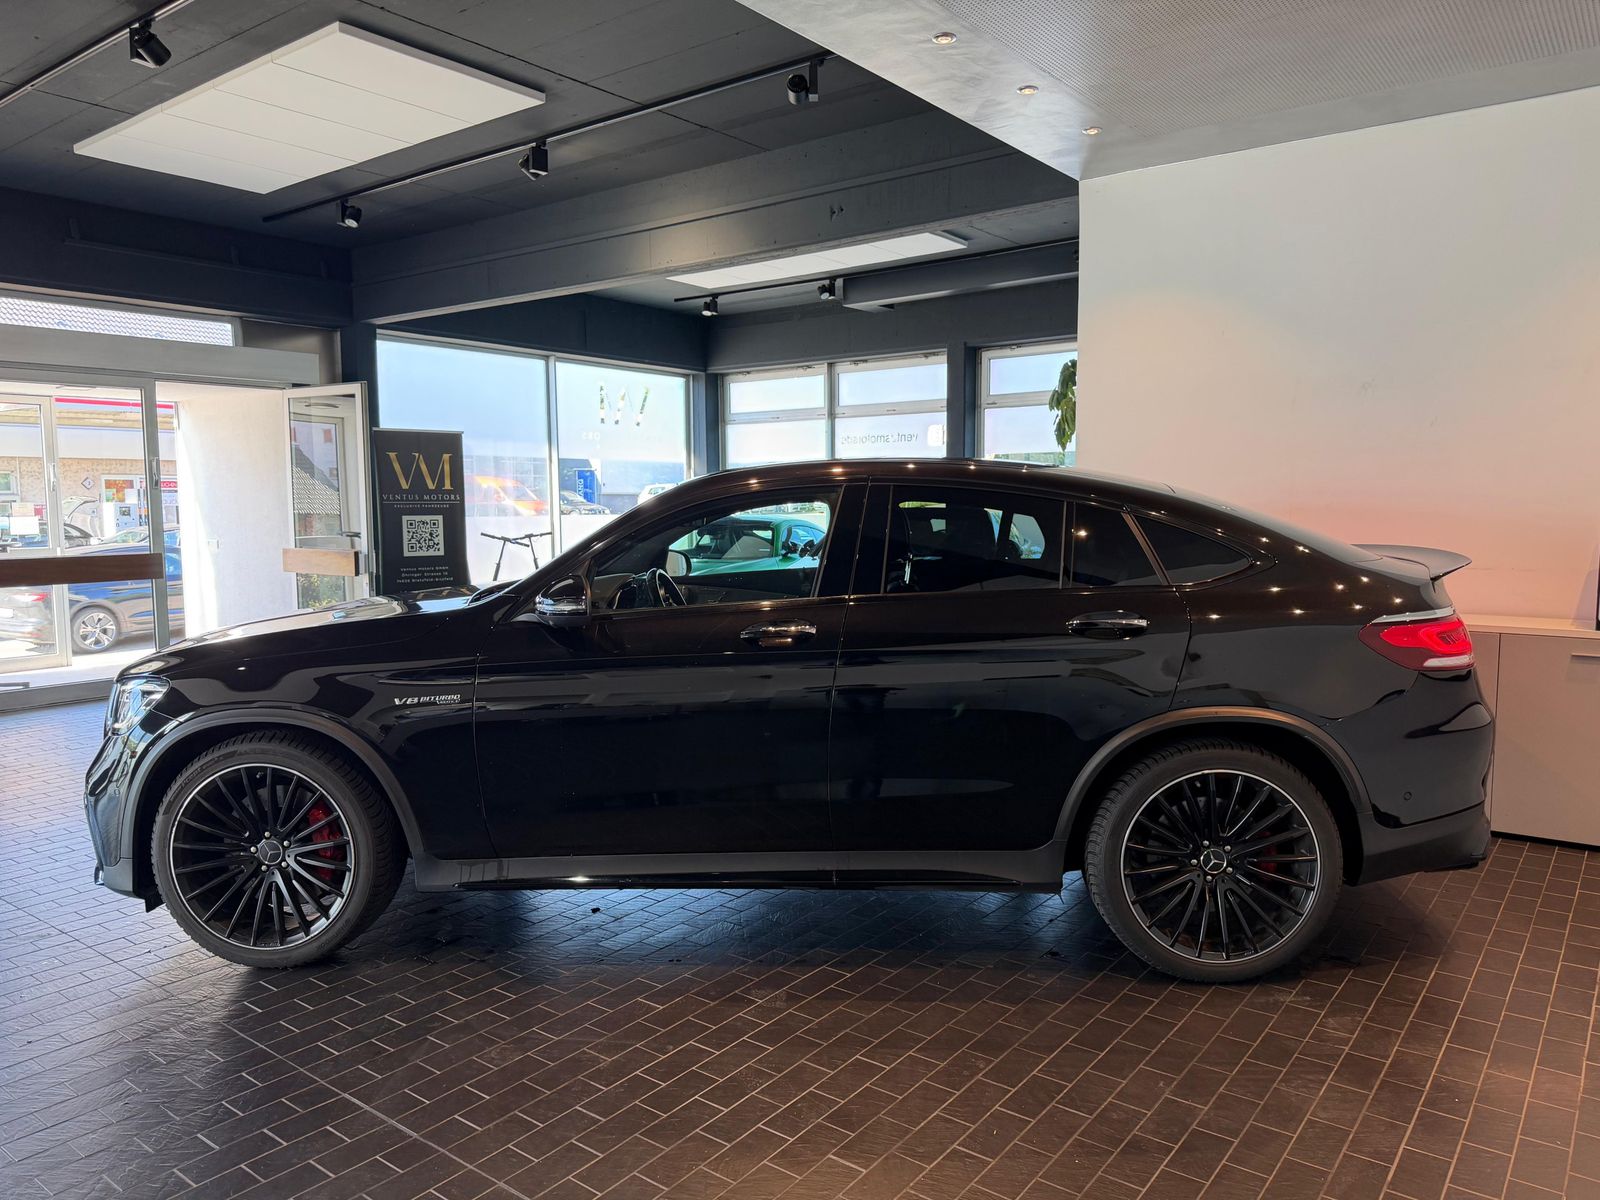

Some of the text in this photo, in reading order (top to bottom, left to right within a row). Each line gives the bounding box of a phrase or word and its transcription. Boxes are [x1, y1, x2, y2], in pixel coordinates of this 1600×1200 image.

[386, 452, 454, 490] VM
[394, 697, 418, 705] V8
[420, 694, 460, 703] BITURBO
